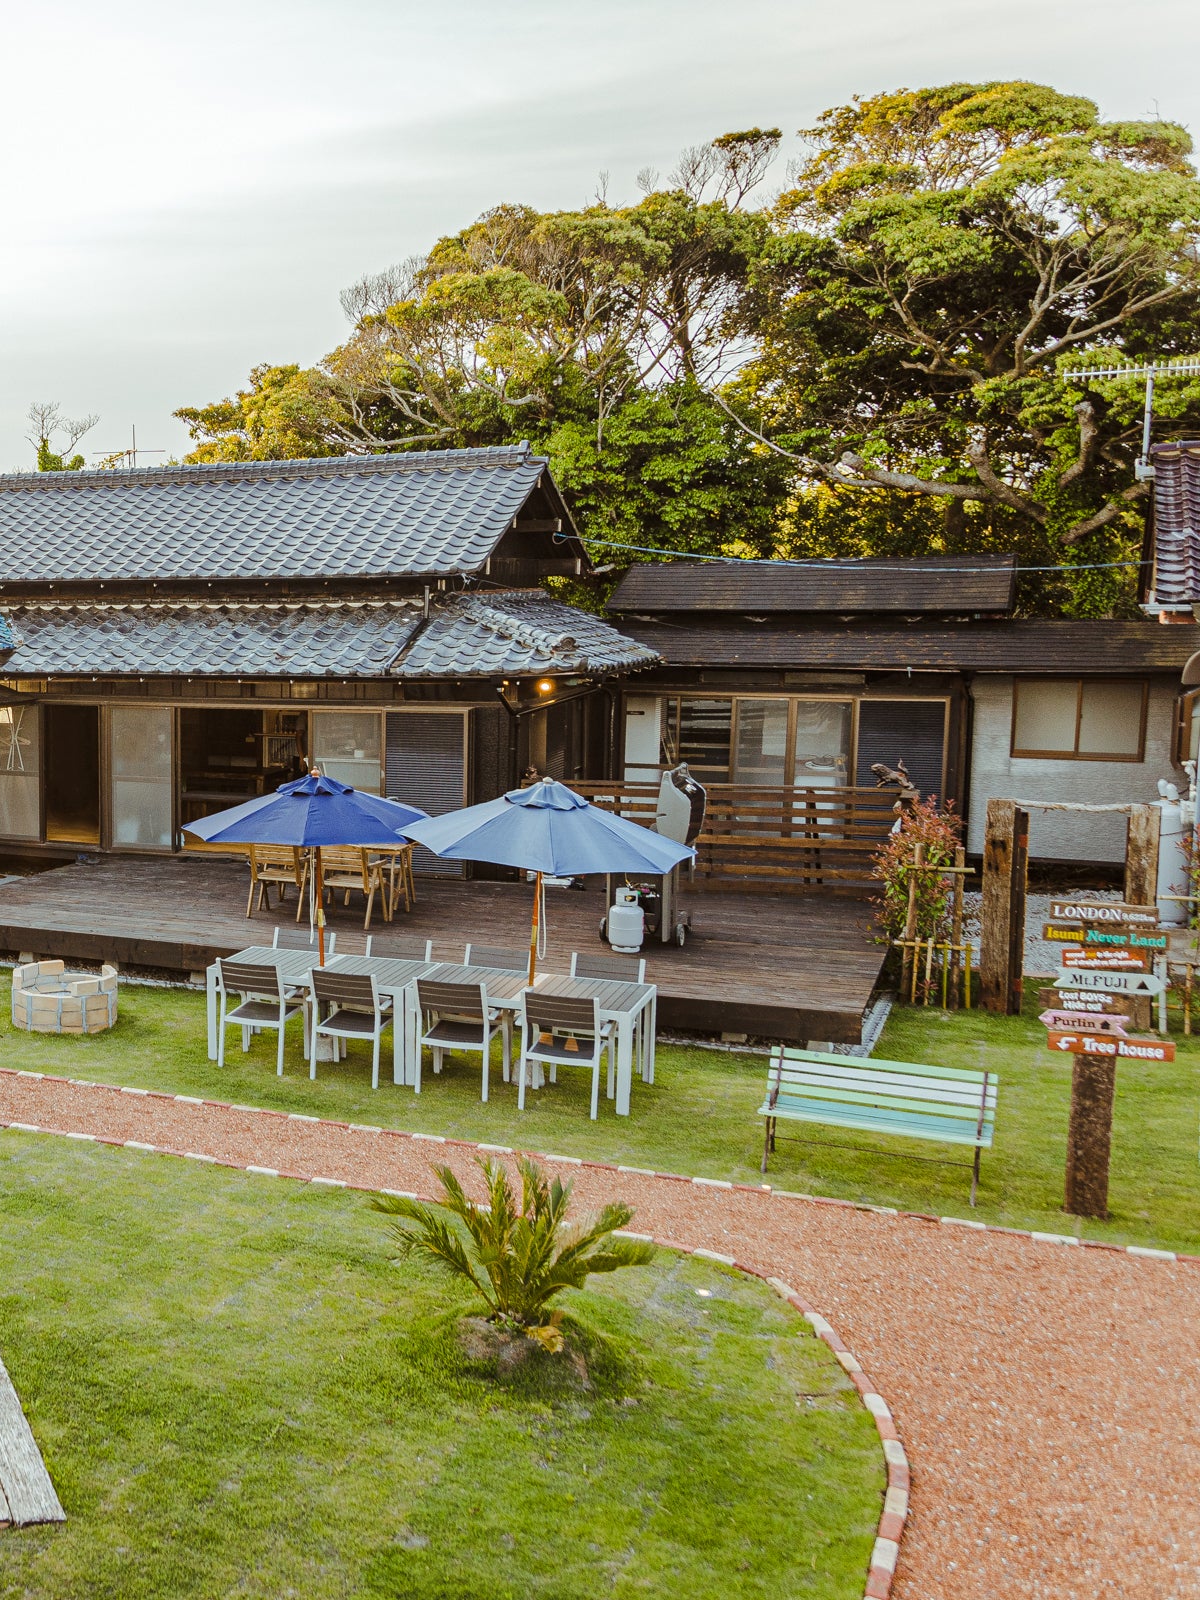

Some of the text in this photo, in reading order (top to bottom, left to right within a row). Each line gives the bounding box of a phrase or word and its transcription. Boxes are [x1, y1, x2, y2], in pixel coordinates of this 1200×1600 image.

[1053, 905, 1122, 921] LONDON
[1047, 927, 1167, 948] Isumi Never Land
[1069, 973, 1128, 989] Mt.FUJI
[1059, 990, 1079, 1000] Lost
[1052, 1016, 1096, 1029] Purlin
[1082, 1037, 1164, 1059] Tree house
